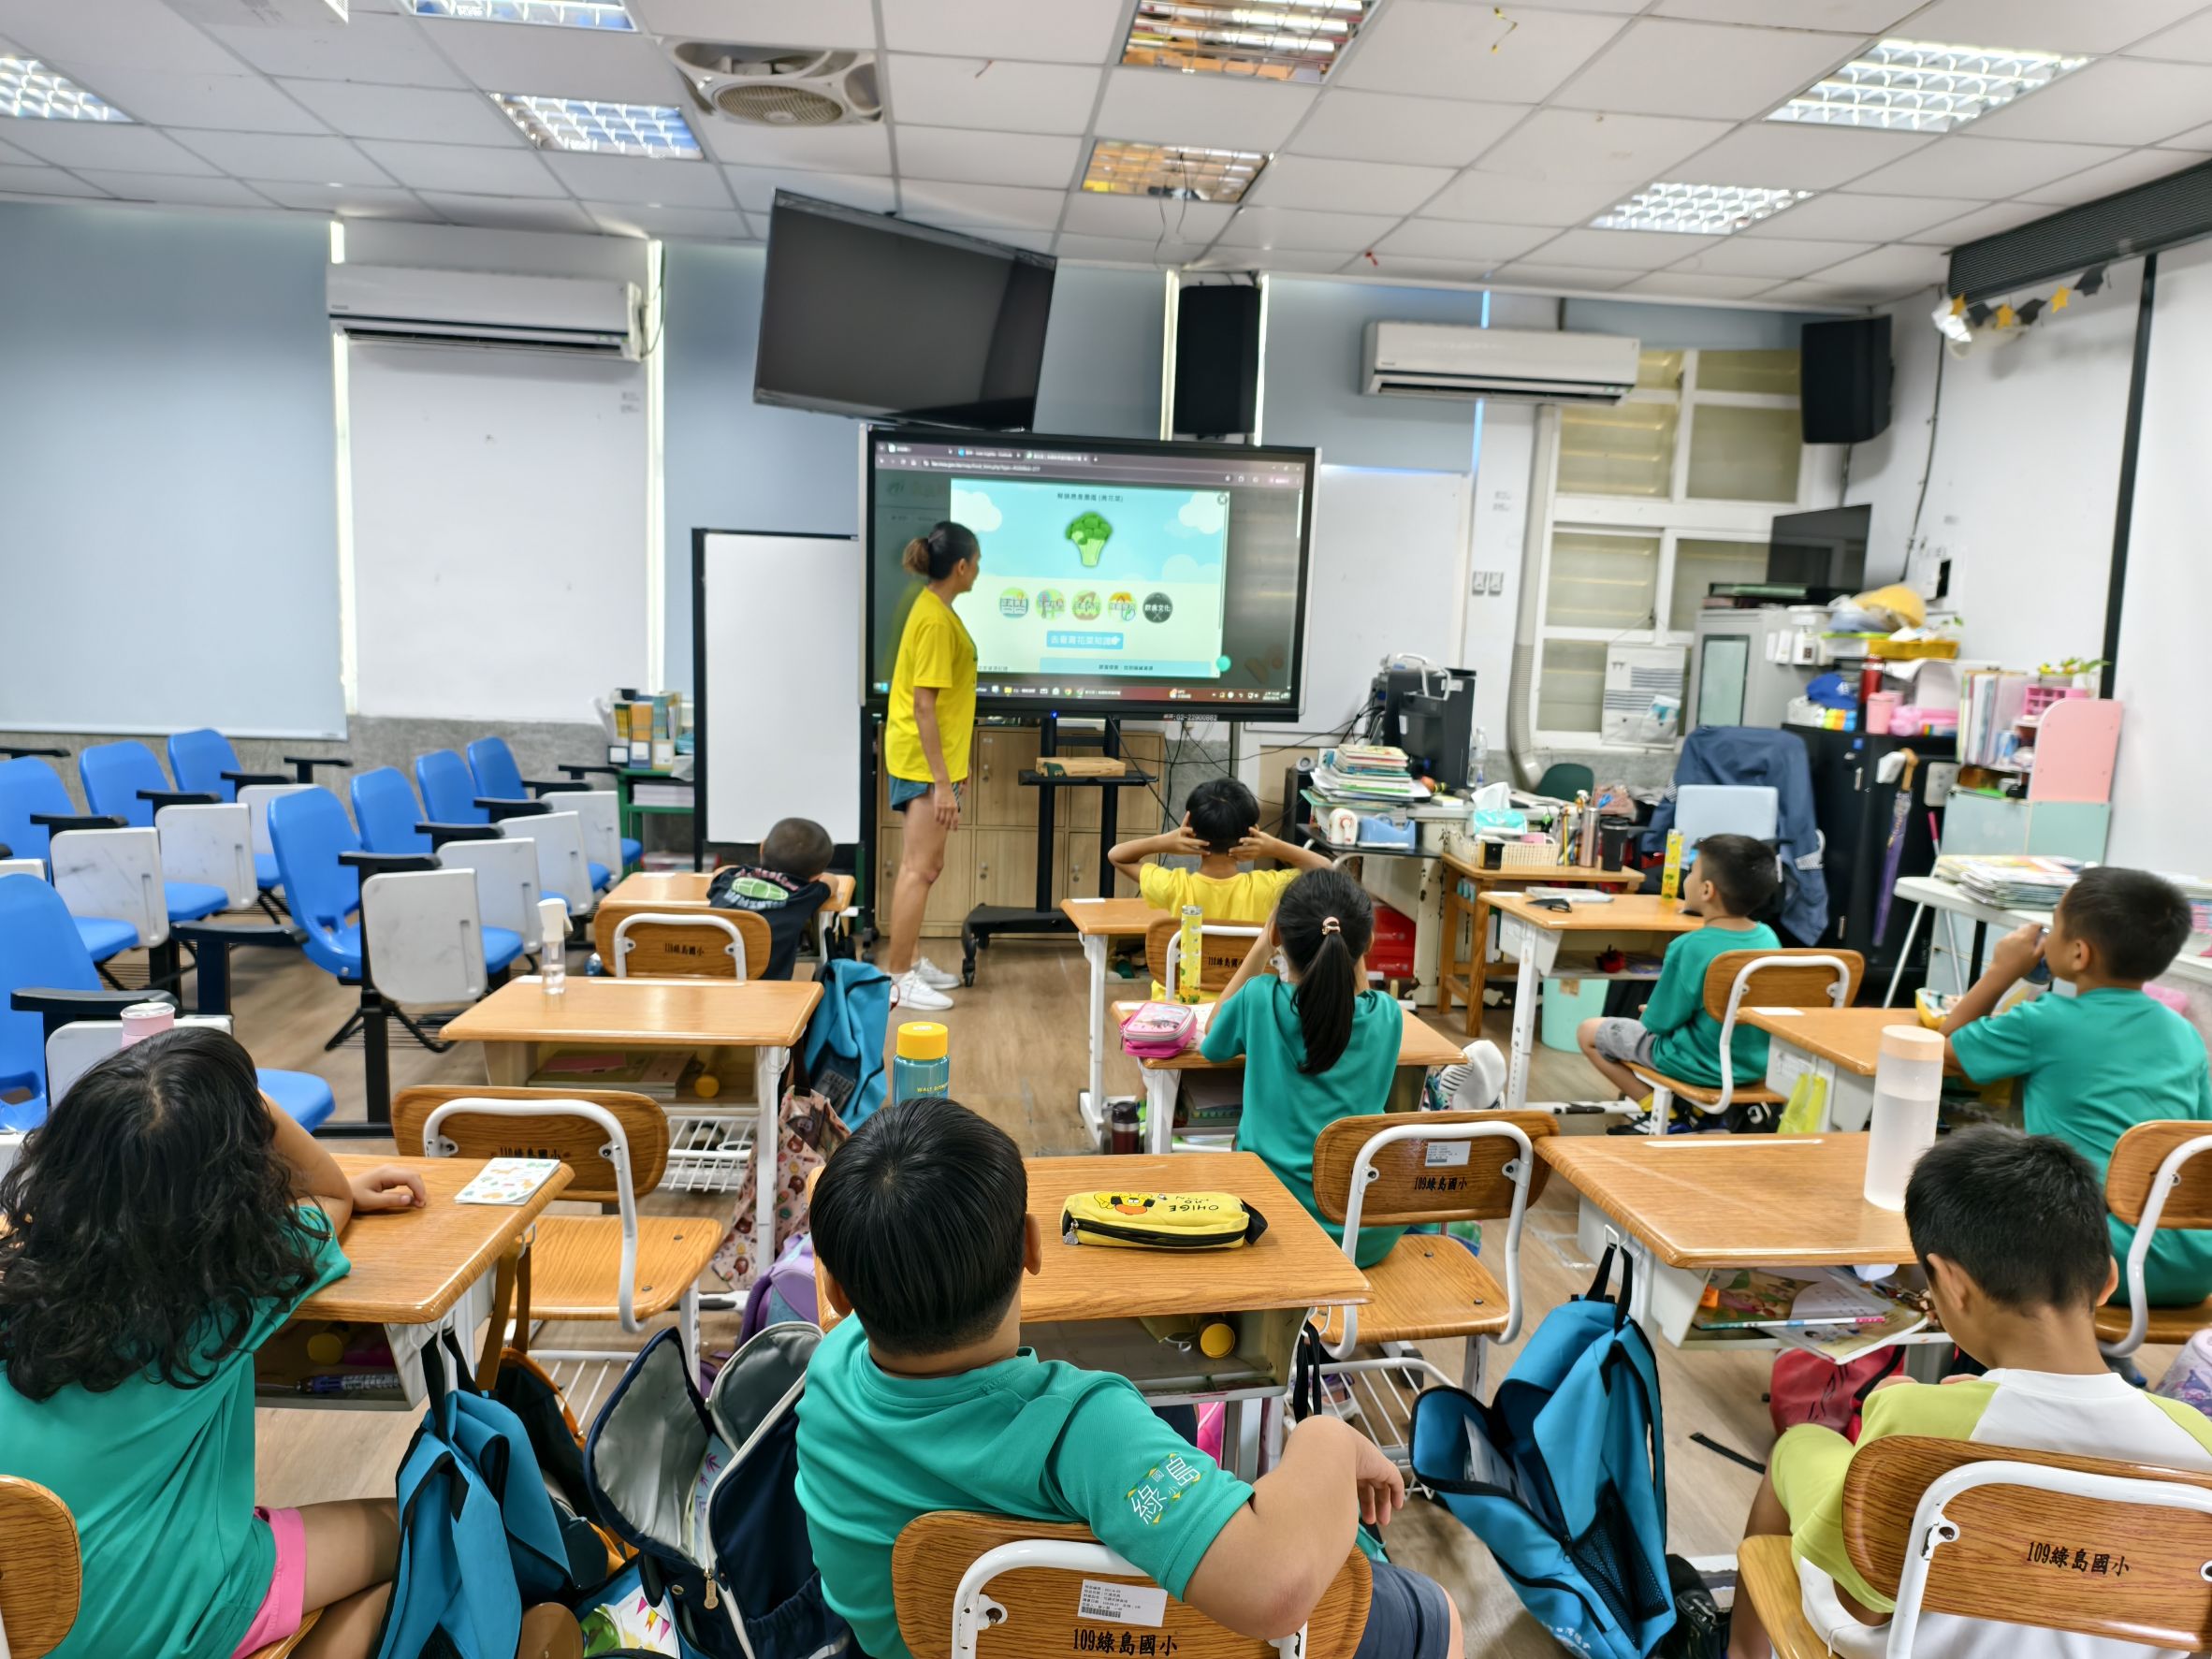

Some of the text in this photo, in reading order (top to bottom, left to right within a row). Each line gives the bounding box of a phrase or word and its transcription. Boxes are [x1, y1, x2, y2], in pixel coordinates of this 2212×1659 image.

[1168, 1204, 1219, 1213] OHIGE
[2027, 1541, 2131, 1577] 109綠島國小
[1073, 1628, 1178, 1657] 109綠島國小
